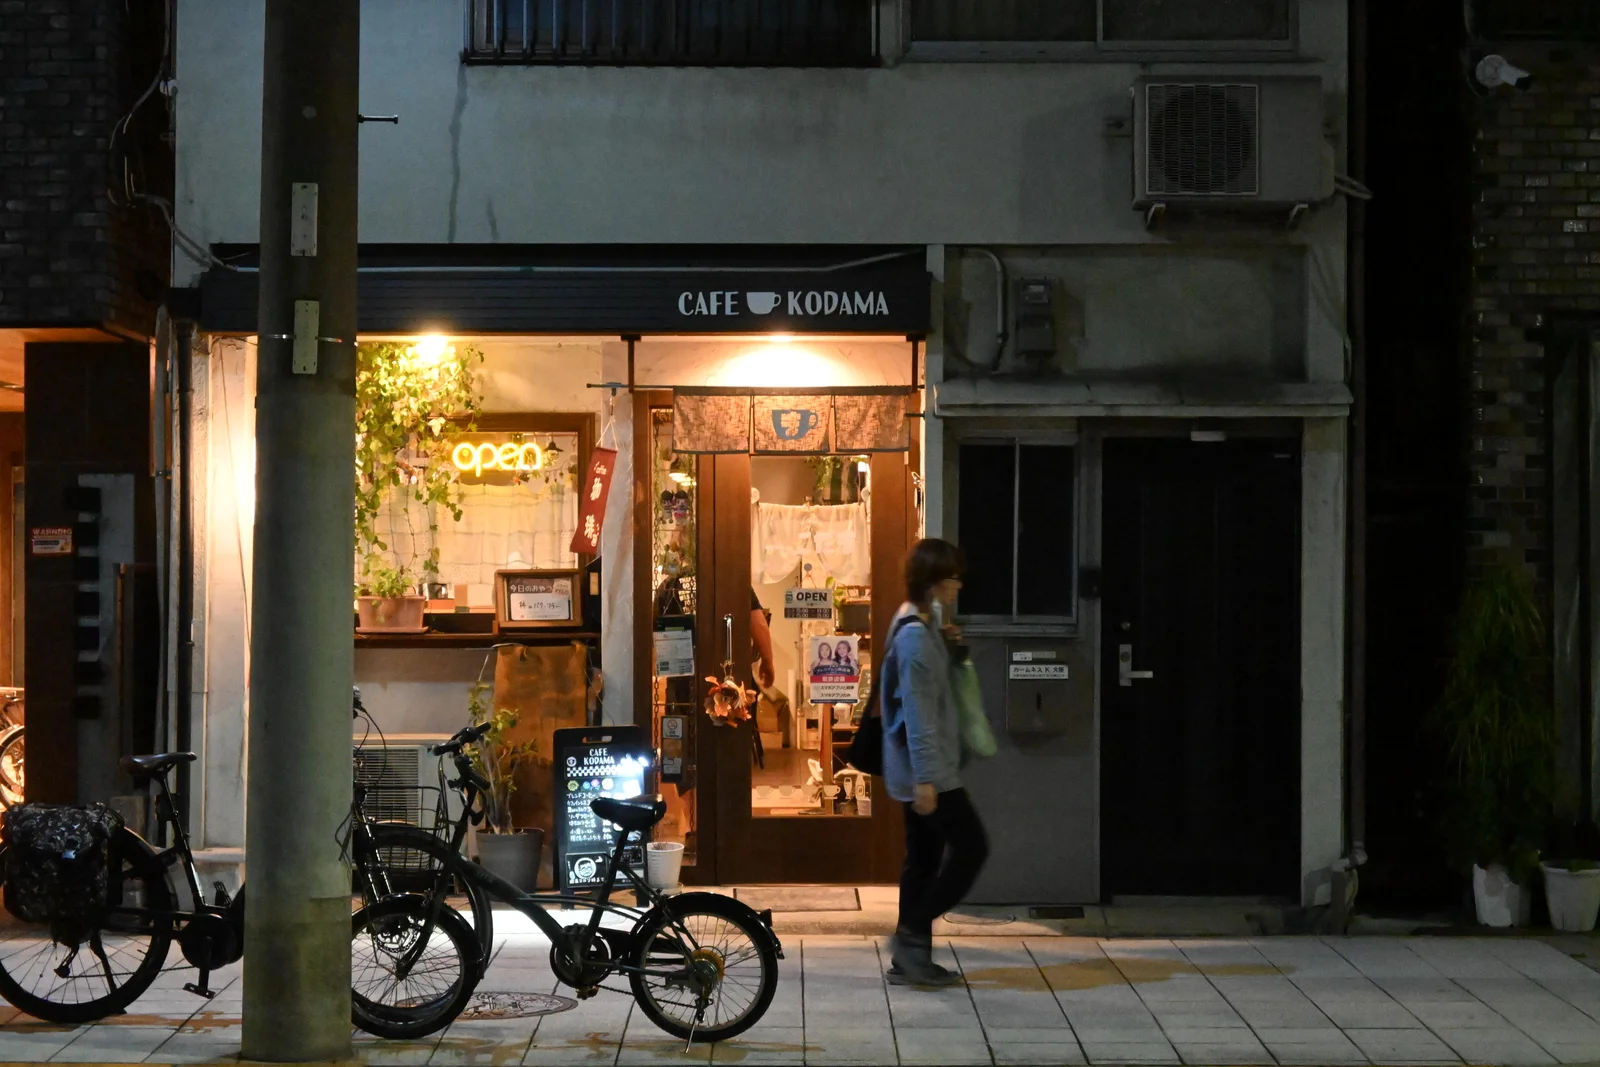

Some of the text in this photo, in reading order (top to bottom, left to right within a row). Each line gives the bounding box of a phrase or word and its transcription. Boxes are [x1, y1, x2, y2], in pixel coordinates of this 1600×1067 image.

[678, 291, 889, 316] CAFE KODAMA
[452, 442, 542, 477] open
[509, 584, 553, 593] 今日のおやつ
[796, 592, 828, 602] OPEN
[589, 748, 608, 757] CAFE
[583, 756, 615, 765] KODAMA
